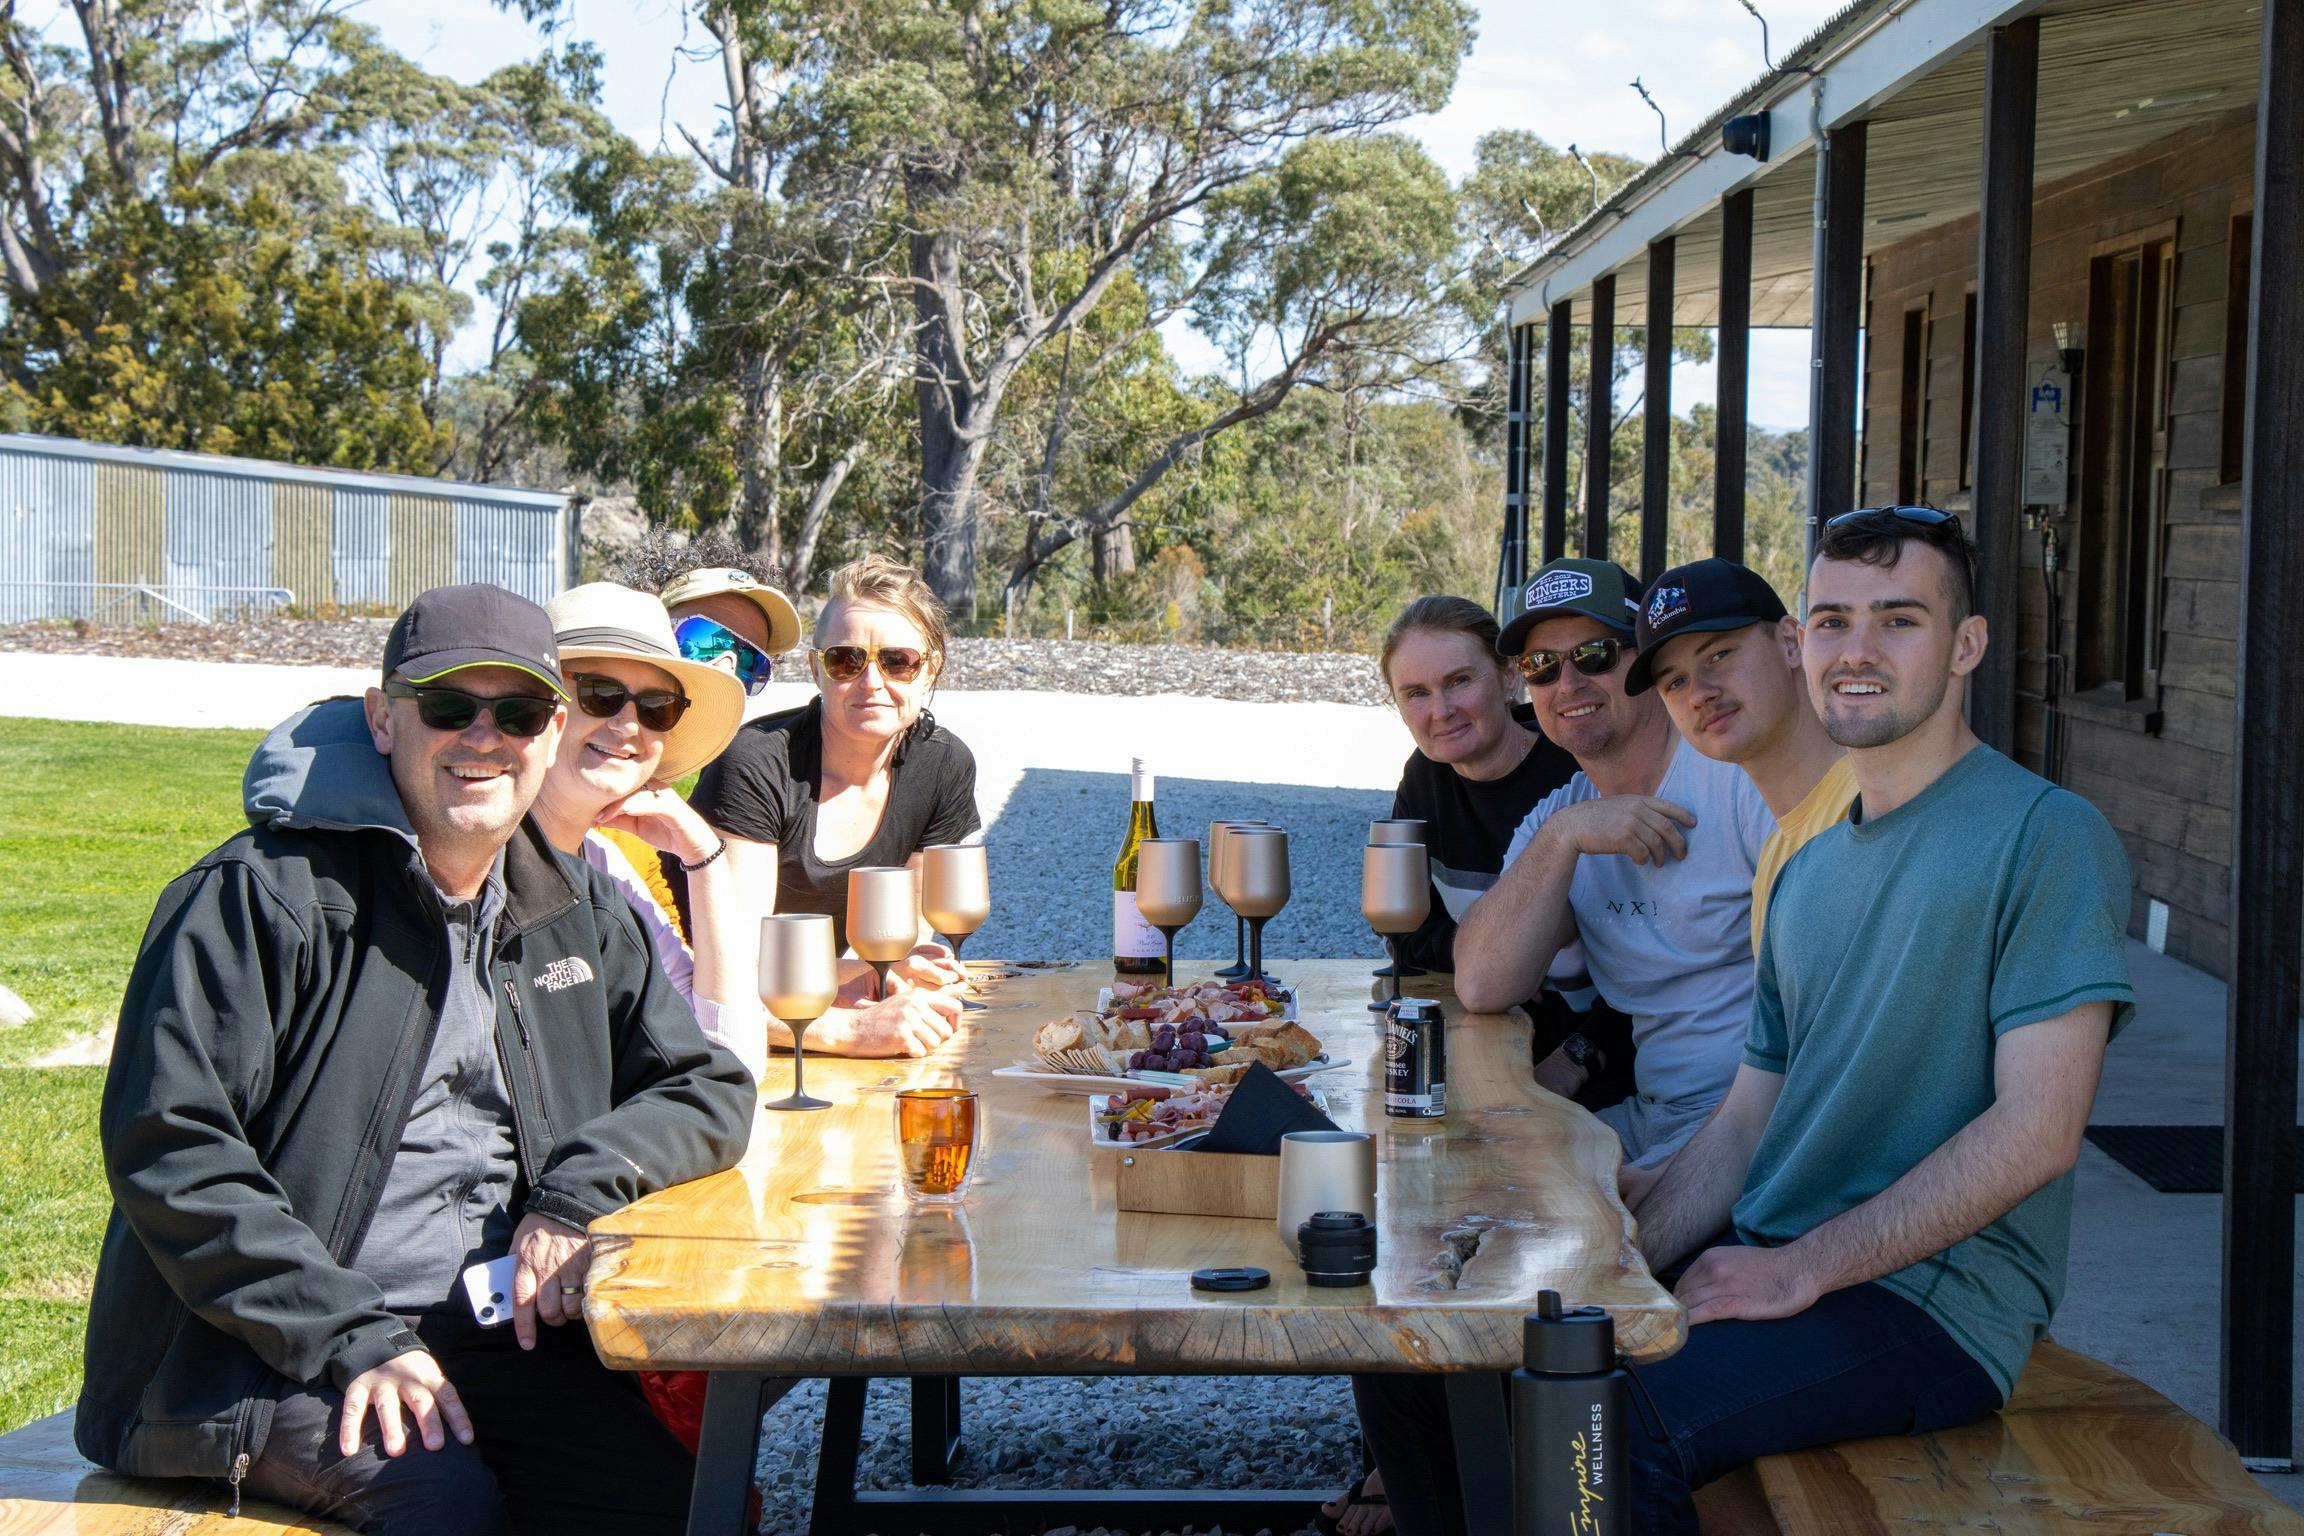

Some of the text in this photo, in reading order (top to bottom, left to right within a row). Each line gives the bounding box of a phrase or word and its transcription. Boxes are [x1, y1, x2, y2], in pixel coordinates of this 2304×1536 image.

[1527, 578, 1588, 604] RINGERS
[1536, 590, 1577, 605] WESTERN
[1656, 605, 1687, 625] Columbia
[545, 958, 569, 973] THE
[533, 967, 572, 988] NORTH
[547, 976, 574, 993] FACE
[1591, 1403, 1603, 1485] WELLNESS
